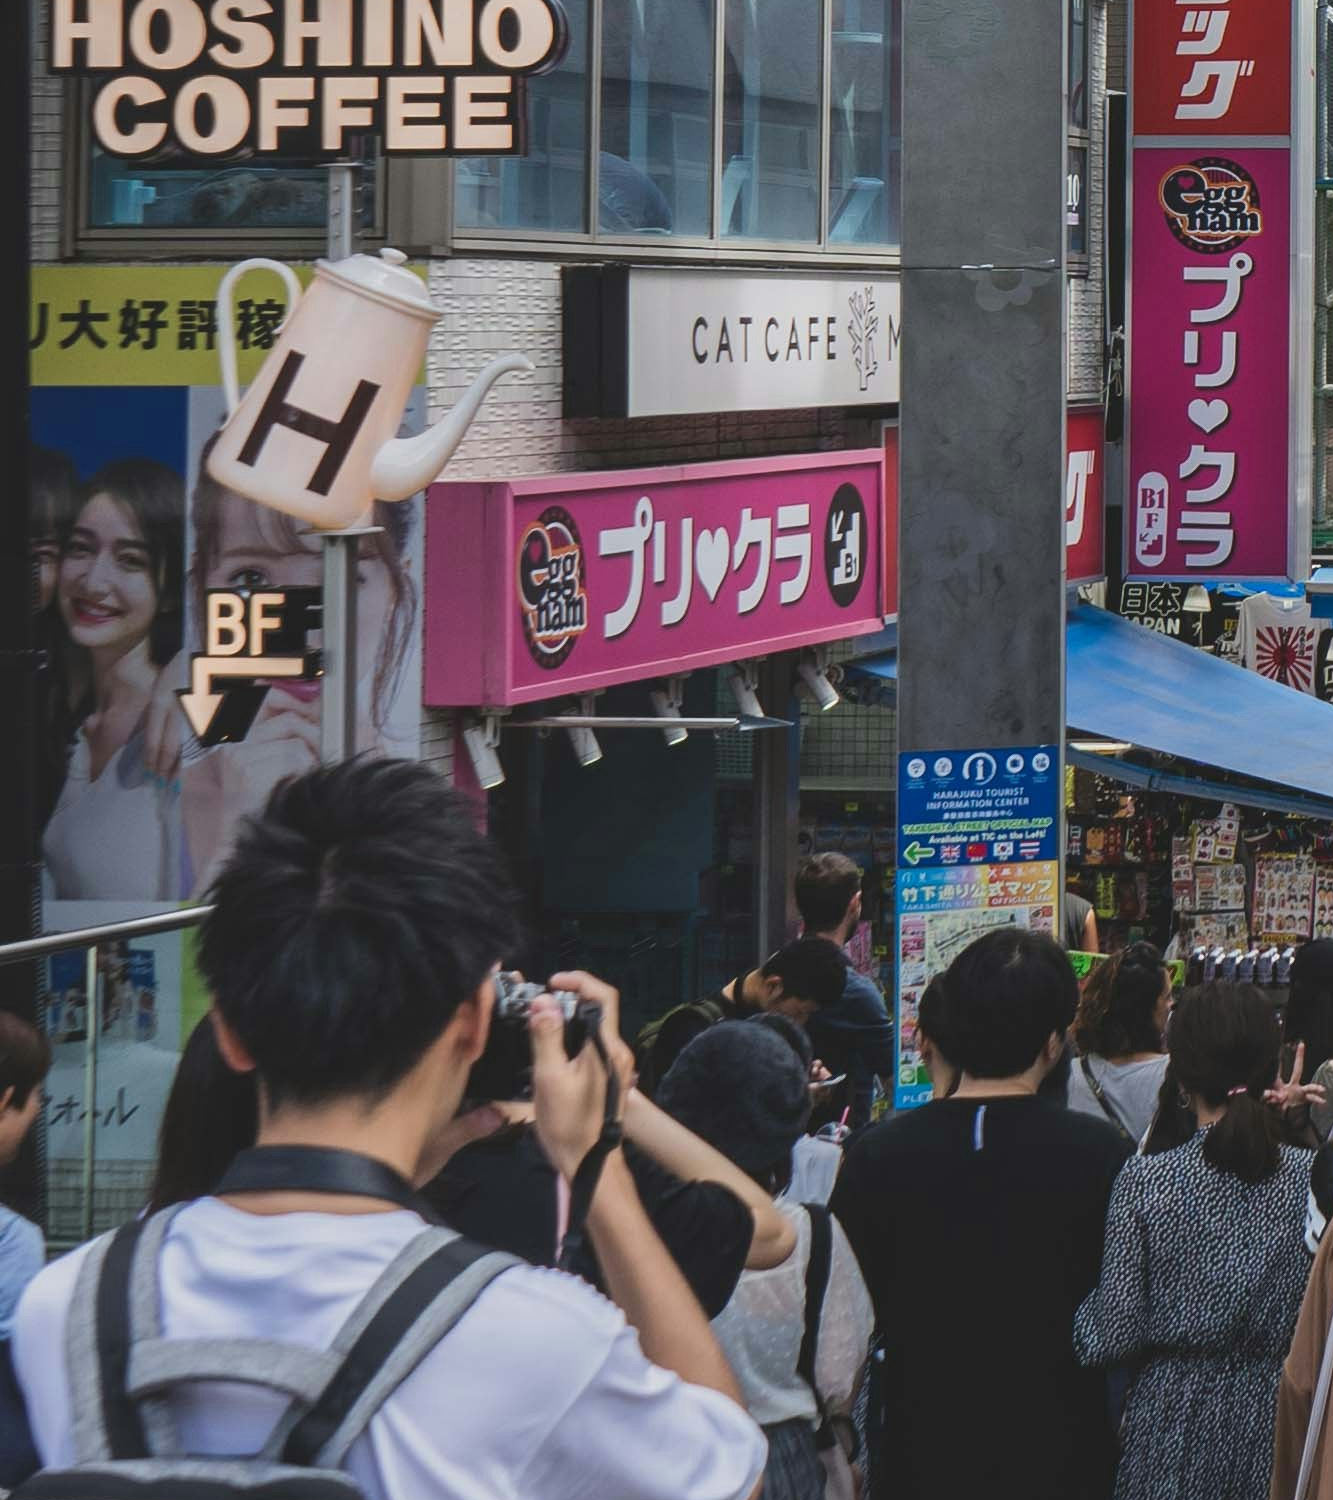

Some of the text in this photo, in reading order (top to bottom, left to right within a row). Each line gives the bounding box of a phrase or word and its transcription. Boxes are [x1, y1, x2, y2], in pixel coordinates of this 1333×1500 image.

[93, 74, 517, 155] COFFEE
[692, 316, 754, 364] CAT
[764, 316, 838, 362] CAFE
[236, 349, 381, 497] H
[844, 553, 858, 580] B1
[1119, 582, 1182, 615] 日本
[206, 592, 285, 657] BF
[926, 797, 1029, 810] INFORMATION CENTER
[933, 787, 1024, 800] HARAJUKU TOURIST
